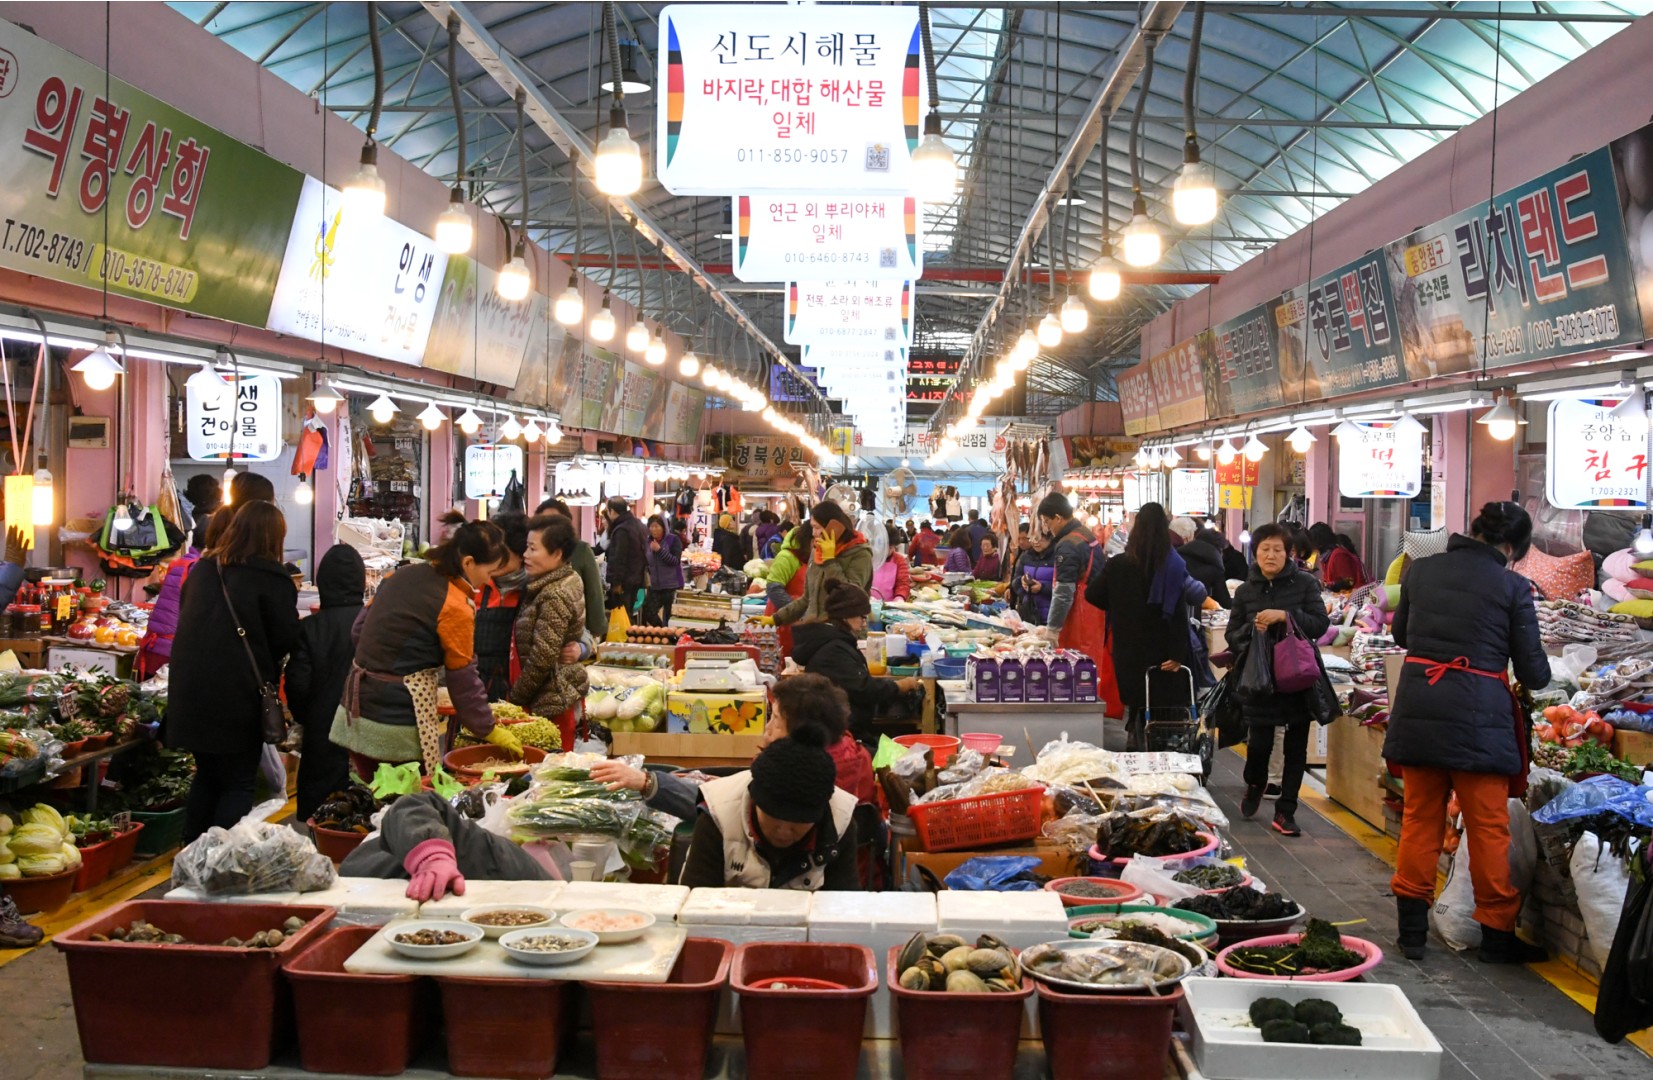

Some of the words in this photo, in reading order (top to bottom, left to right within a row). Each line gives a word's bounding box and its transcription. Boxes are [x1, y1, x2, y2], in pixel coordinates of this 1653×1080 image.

[710, 31, 881, 66] 신도시해물
[703, 78, 812, 105] 바지락,대합
[820, 80, 886, 107] 해산물
[773, 111, 815, 138] 일체
[22, 76, 210, 241] 의령상회
[737, 149, 848, 163] 011-850-9057
[769, 202, 798, 222] 연근
[805, 203, 818, 218] 외
[825, 202, 886, 219] 뿌리야채
[813, 224, 842, 243] 일체
[1454, 169, 1610, 319] 리치랜드
[2, 218, 84, 269] T.702-8743
[99, 248, 194, 300] 010-3578-8747
[785, 253, 869, 263] 010-6460-8743
[1410, 240, 1445, 271] 중앙침구
[394, 242, 434, 303] 인생
[830, 295, 848, 306] 소라
[852, 296, 860, 306] 외
[1418, 274, 1451, 306] 혼수전문
[1308, 260, 1391, 363] 종로떡집
[201, 417, 257, 437] 건어물
[736, 445, 803, 466] 경북상회
[1371, 447, 1395, 470] 떡
[1591, 487, 1638, 496] T.703-2321
